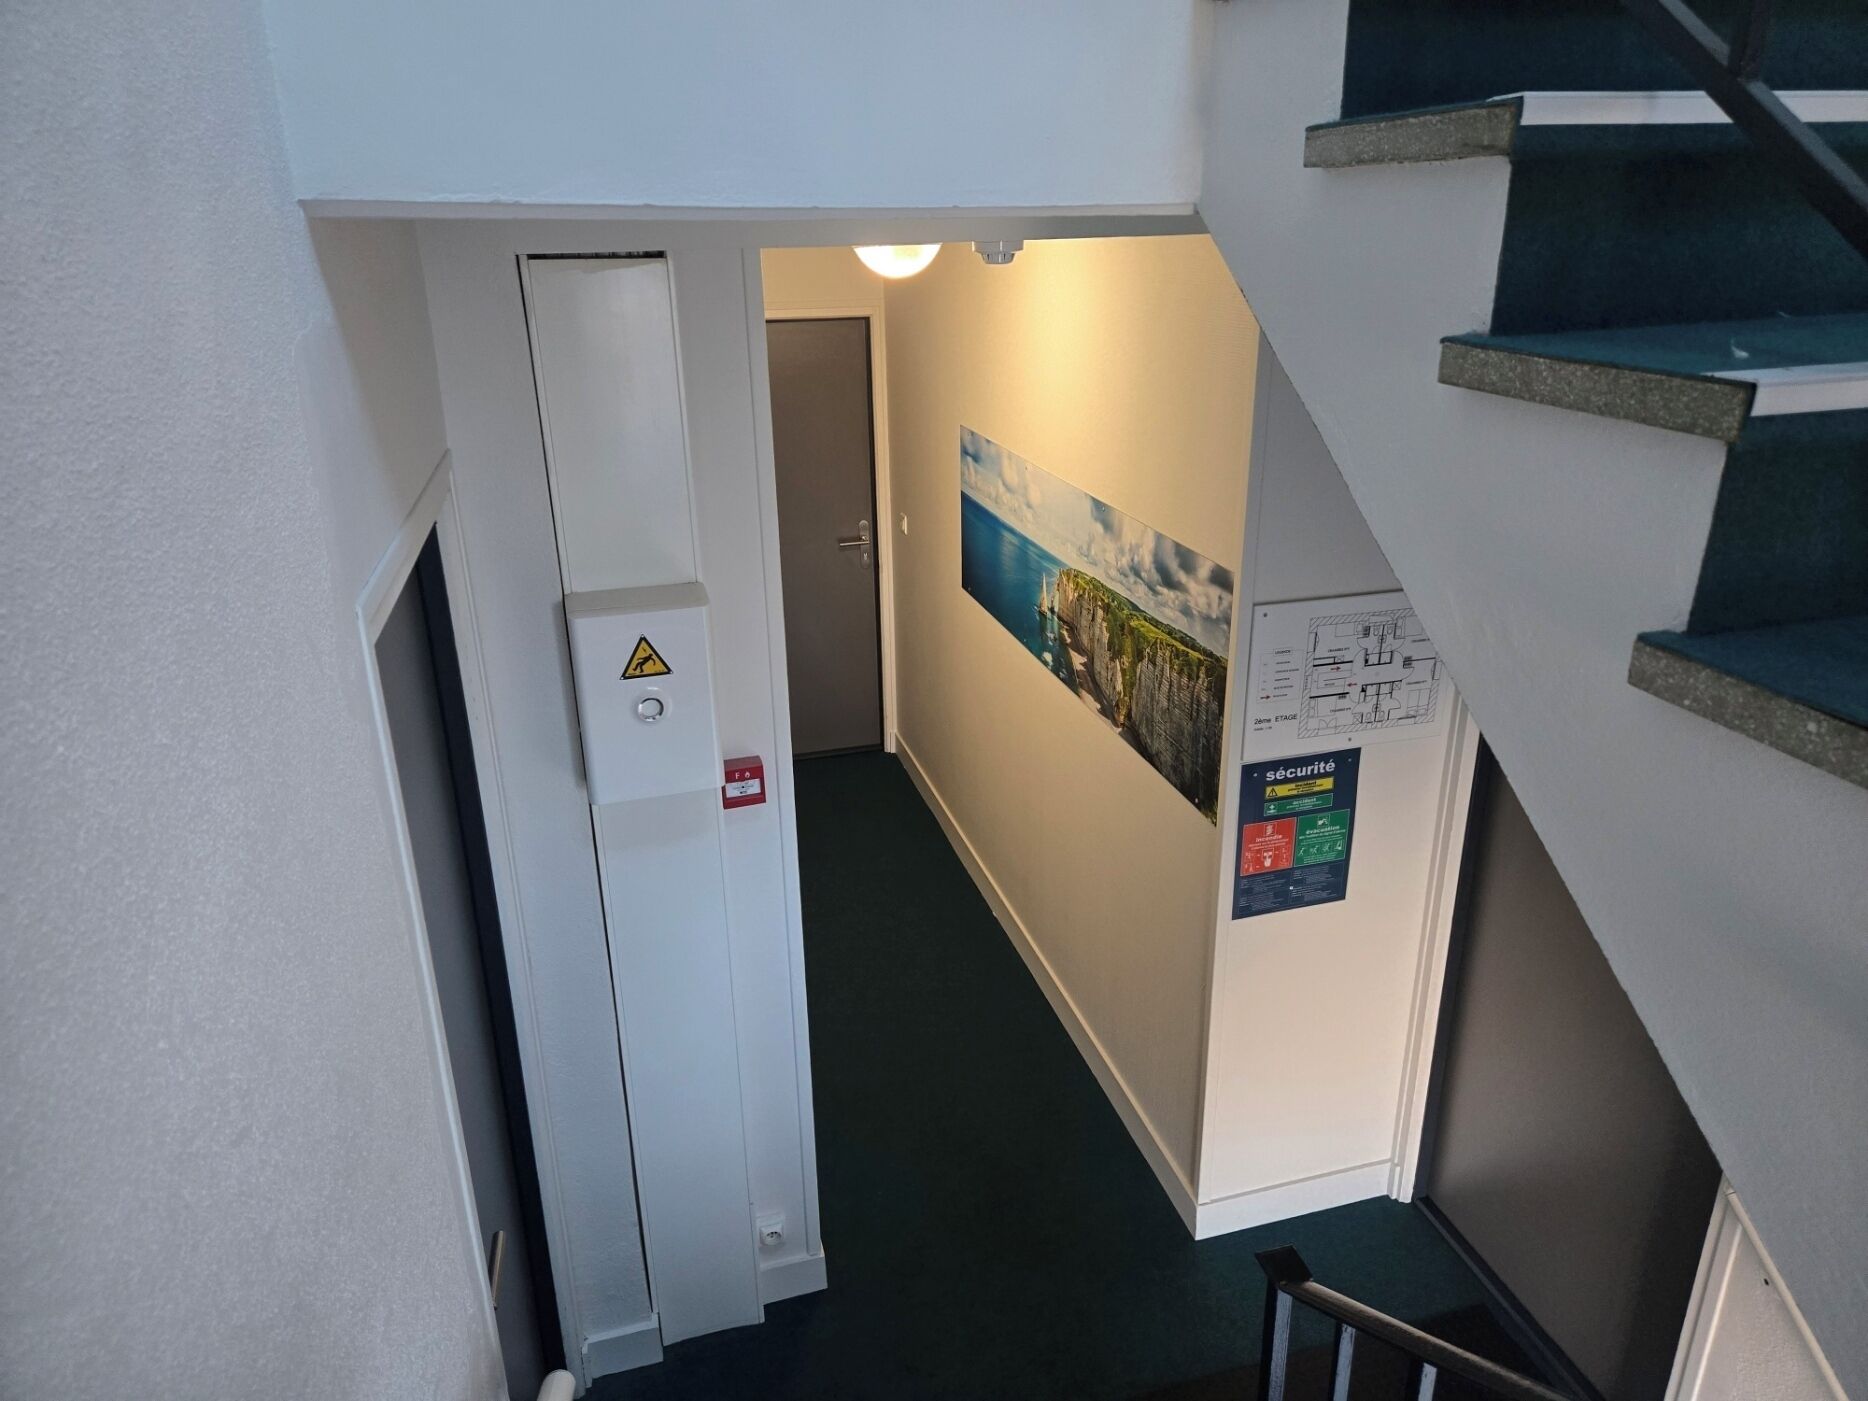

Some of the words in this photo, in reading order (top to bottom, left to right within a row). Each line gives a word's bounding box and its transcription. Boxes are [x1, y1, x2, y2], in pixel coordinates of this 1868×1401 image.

[1253, 716, 1272, 725] 2ème
[1274, 713, 1298, 723] ETAGE
[1266, 758, 1336, 782] sécurité
[1255, 833, 1283, 843] incendie
